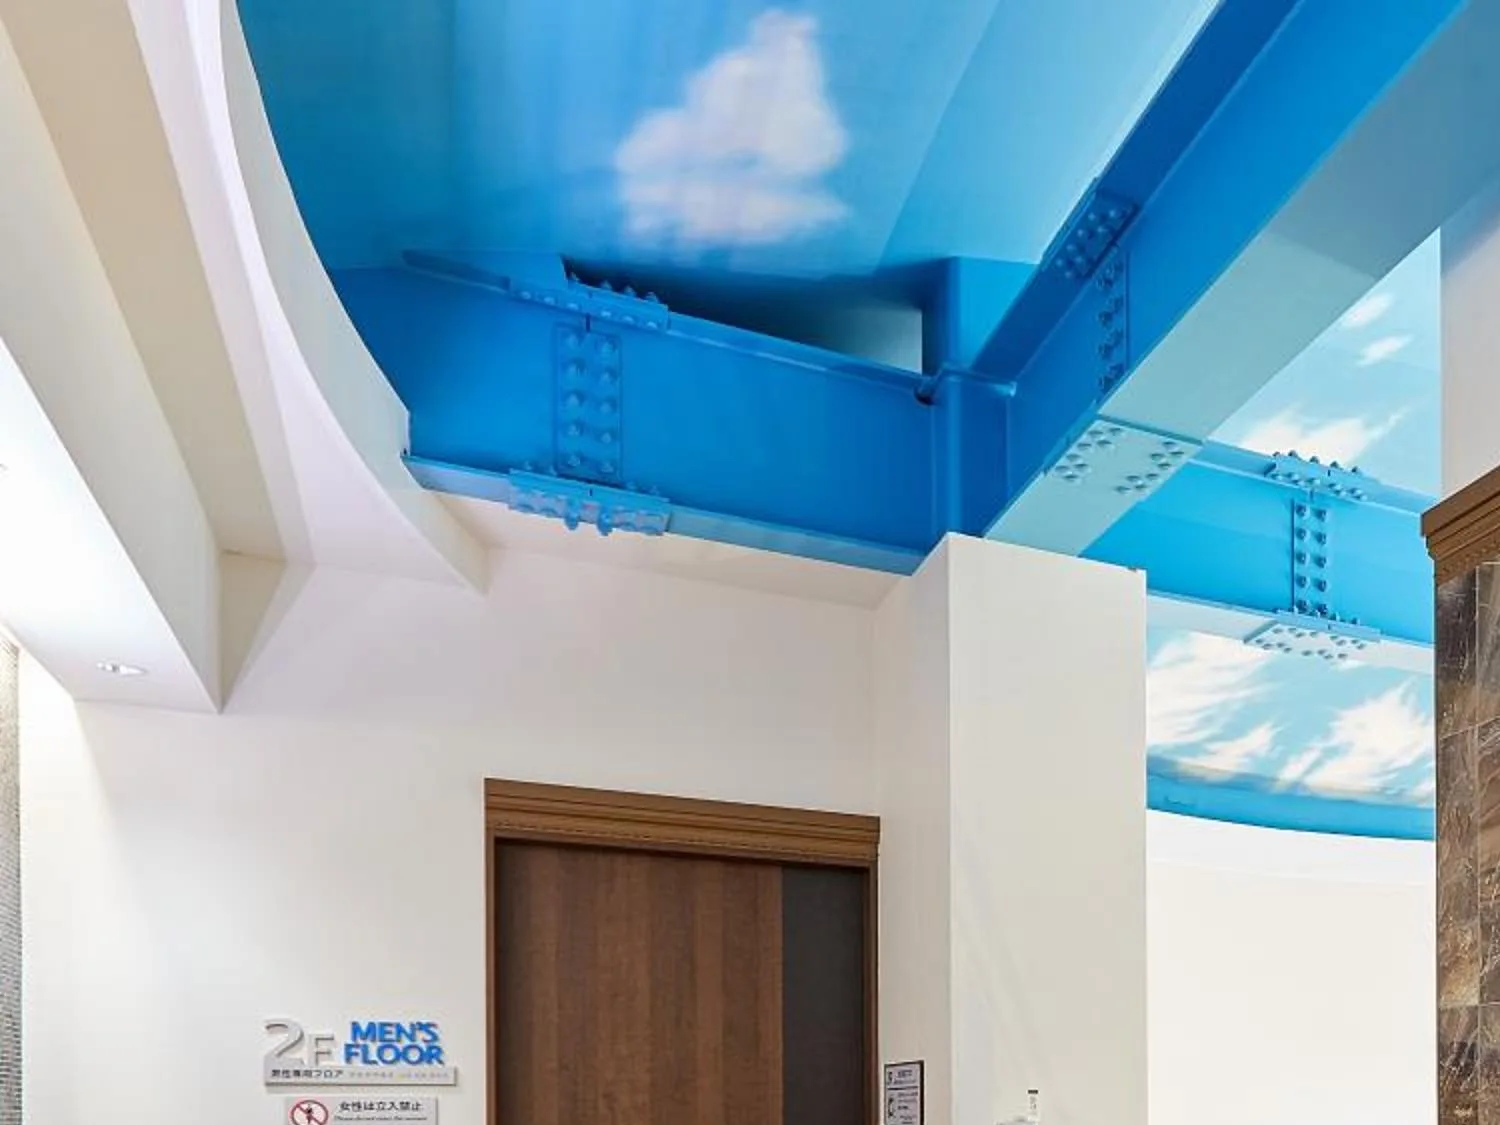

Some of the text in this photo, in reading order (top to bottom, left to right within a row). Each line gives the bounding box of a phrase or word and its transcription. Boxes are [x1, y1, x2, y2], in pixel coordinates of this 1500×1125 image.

[264, 1018, 335, 1067] 2F
[350, 1021, 440, 1043] MEN'S
[343, 1043, 445, 1065] FLOOR
